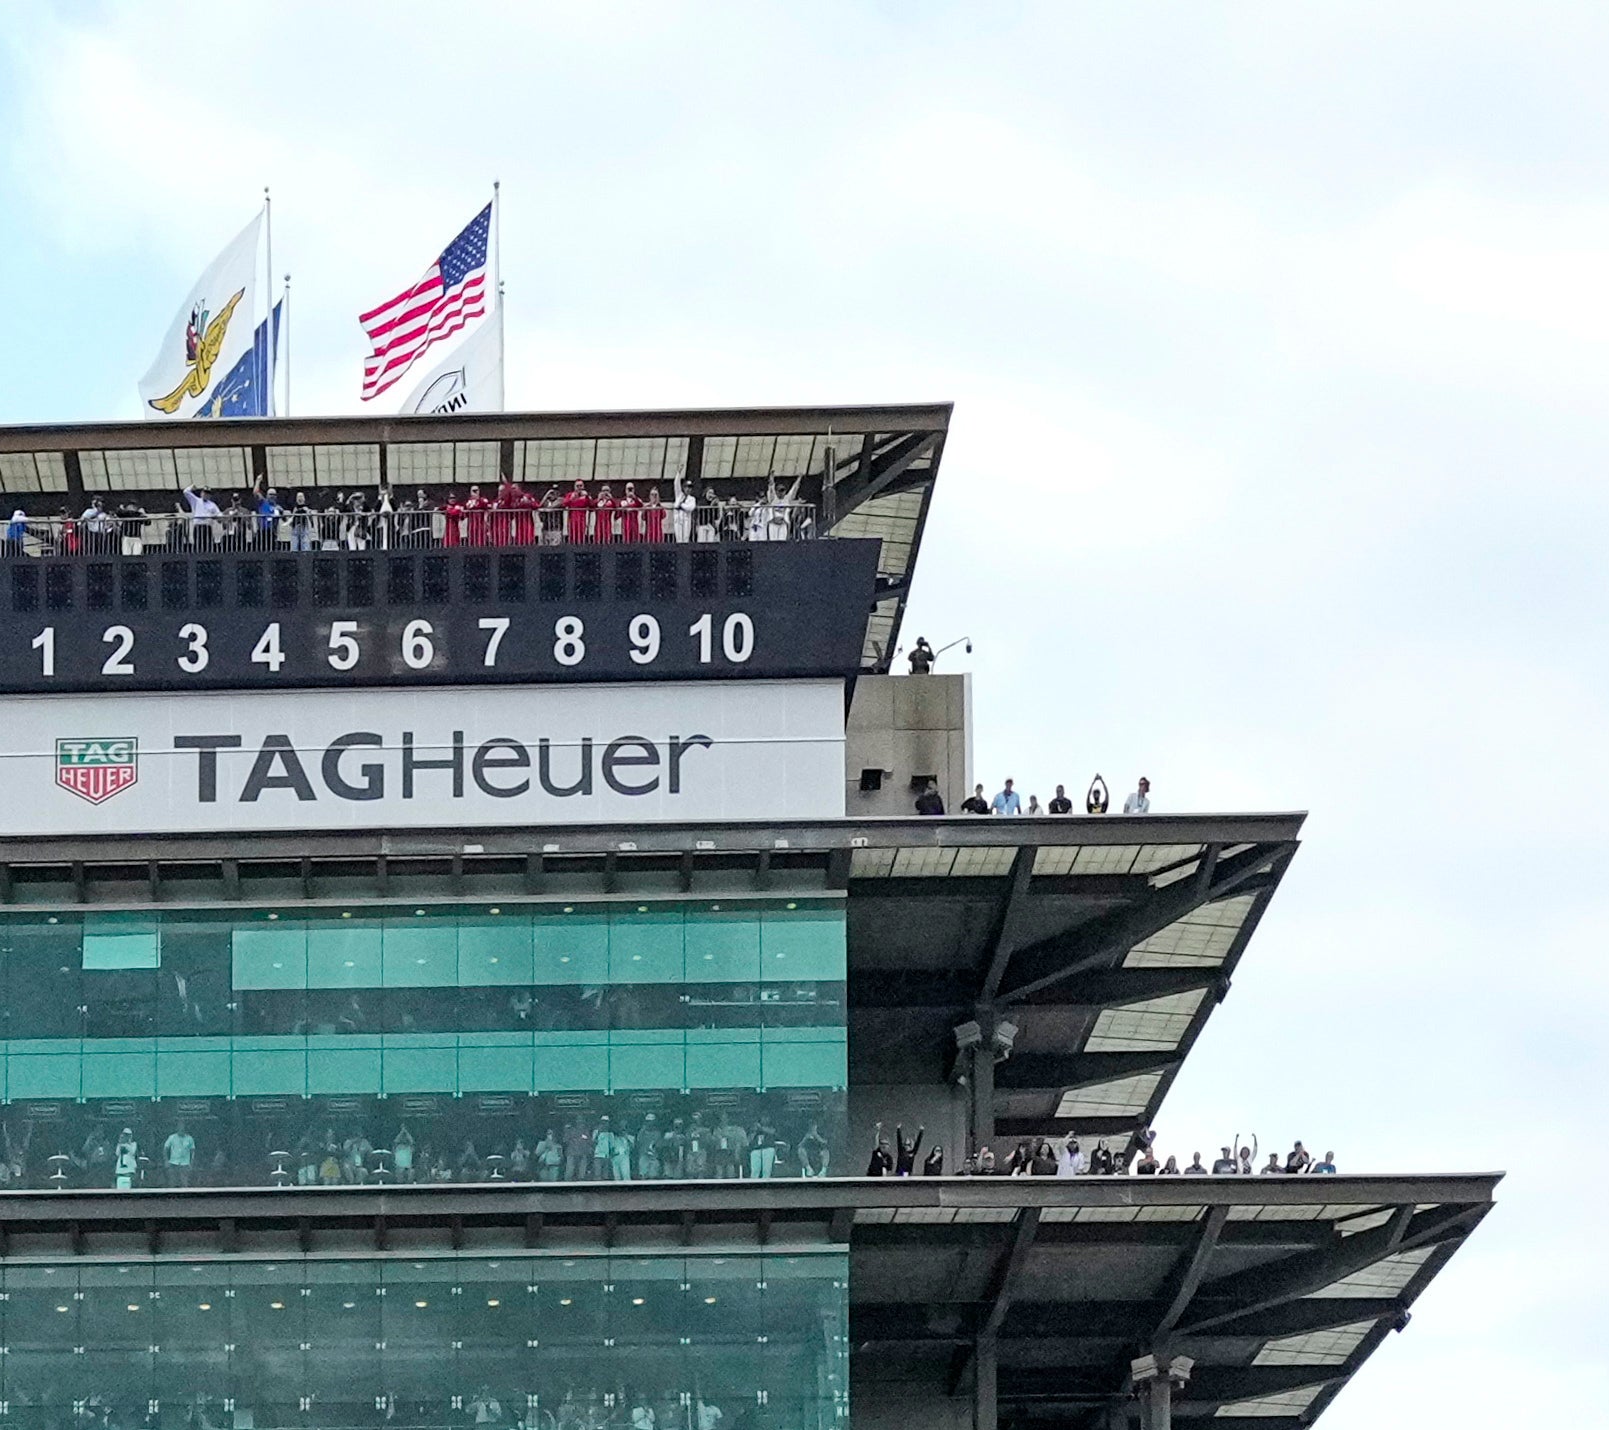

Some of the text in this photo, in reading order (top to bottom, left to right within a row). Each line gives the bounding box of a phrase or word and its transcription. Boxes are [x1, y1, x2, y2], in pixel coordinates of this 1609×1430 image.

[31, 612, 754, 677] 1 2 3 4 5 6 7 8 9 10
[61, 743, 131, 763] TAG
[60, 766, 135, 800] HEUER
